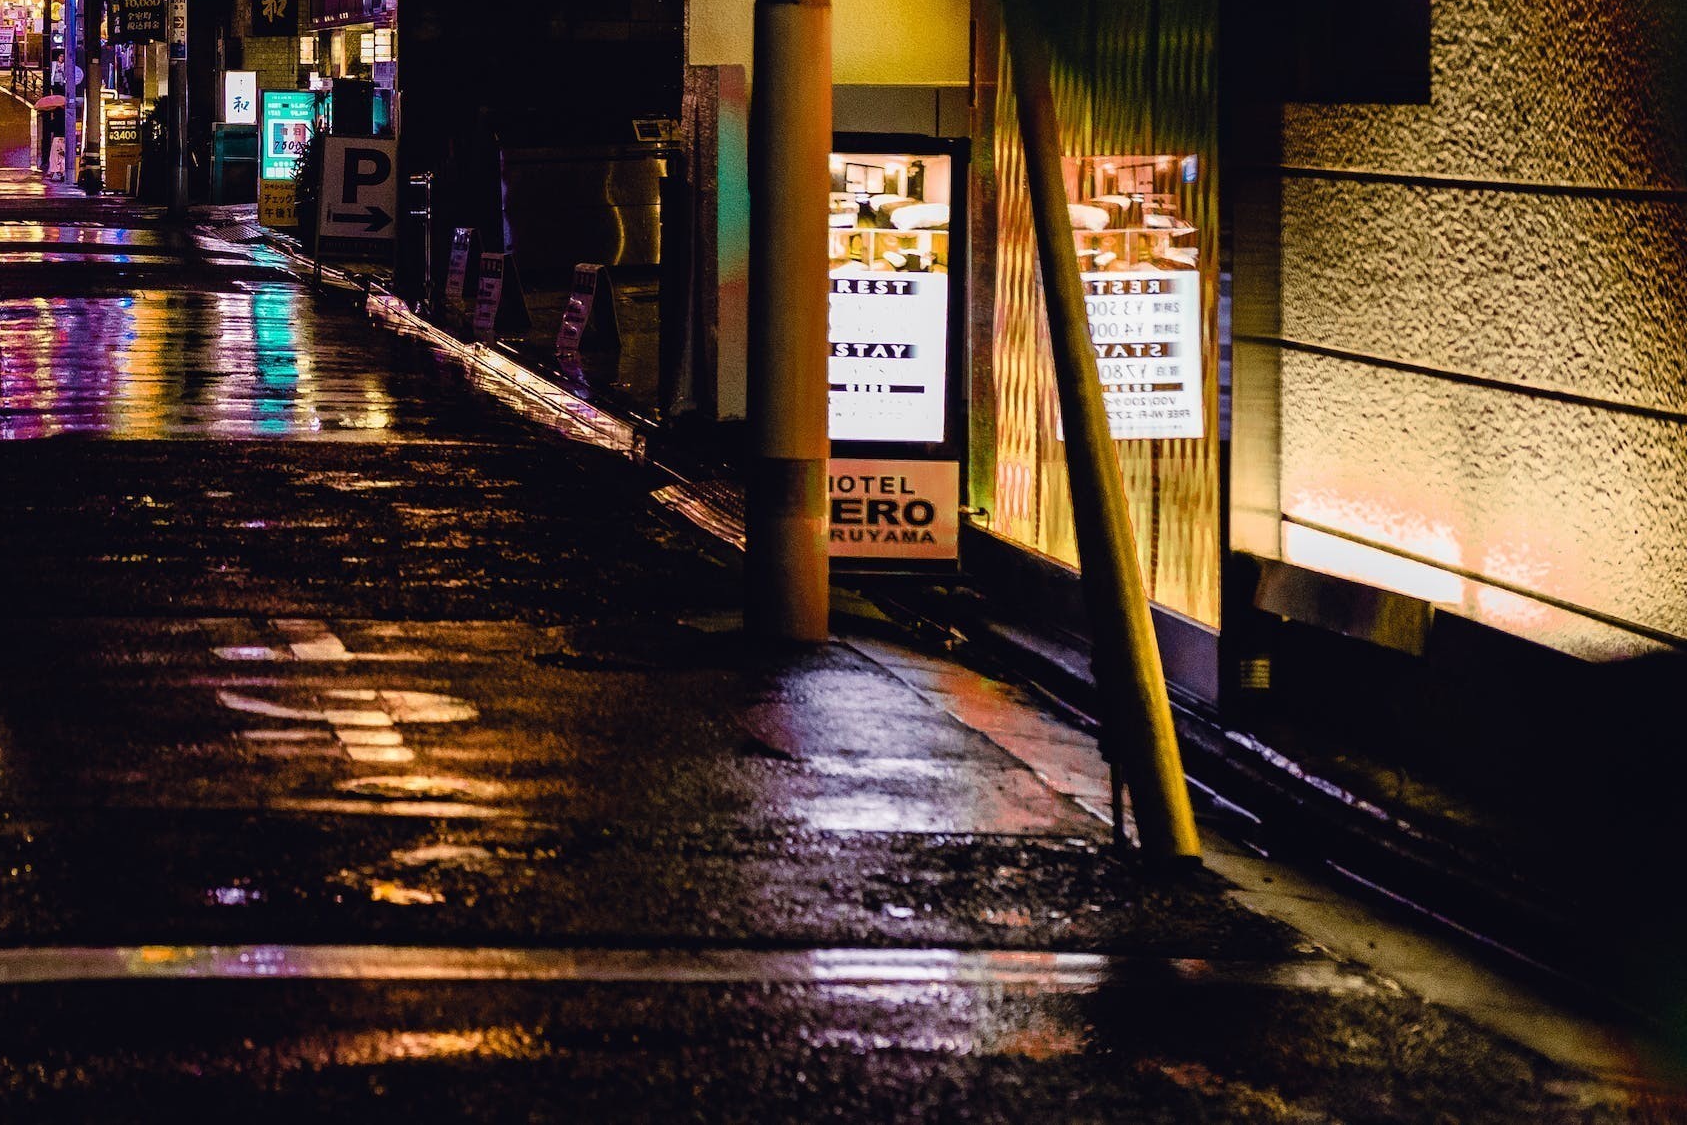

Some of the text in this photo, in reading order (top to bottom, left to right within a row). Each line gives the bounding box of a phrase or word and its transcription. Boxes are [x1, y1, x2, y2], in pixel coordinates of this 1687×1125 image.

[233, 96, 250, 113] 和
[341, 147, 392, 204] P
[836, 279, 908, 295] REST
[835, 343, 906, 358] STAY
